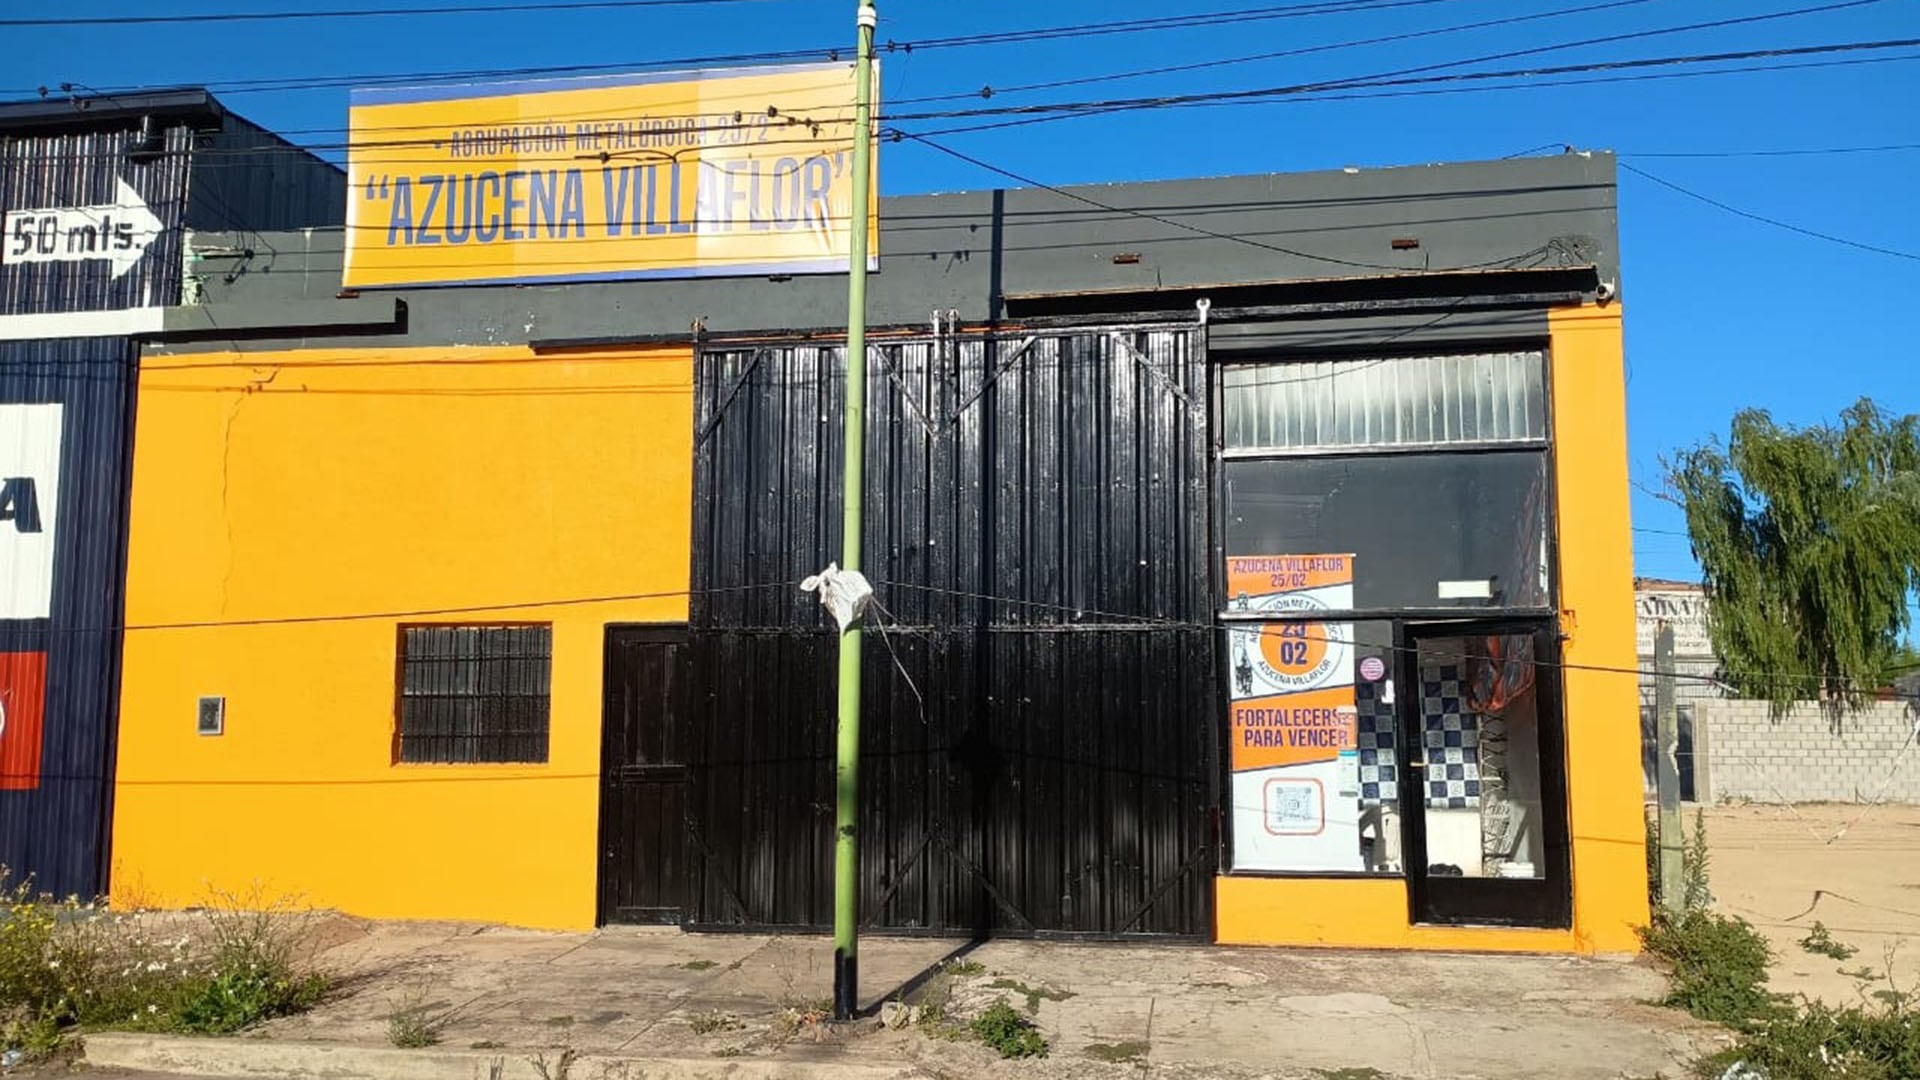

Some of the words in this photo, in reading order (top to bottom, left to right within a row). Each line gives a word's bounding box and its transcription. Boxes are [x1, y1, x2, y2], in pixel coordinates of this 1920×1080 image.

[451, 119, 567, 158] AGRUPACIÓN
[576, 116, 708, 151] METALÚRGICA
[12, 215, 58, 257] 50
[67, 214, 142, 254] mts.
[1234, 558, 1282, 573] AZUCENA
[1286, 556, 1344, 573] VILLAFLOR
[1271, 573, 1307, 588] 25/02
[1280, 641, 1308, 666] 02
[1257, 660, 1291, 684] AZUCENA
[1292, 659, 1332, 685] VILLAFLOR
[1244, 729, 1284, 747] PARA
[1289, 729, 1348, 747] VENCER
